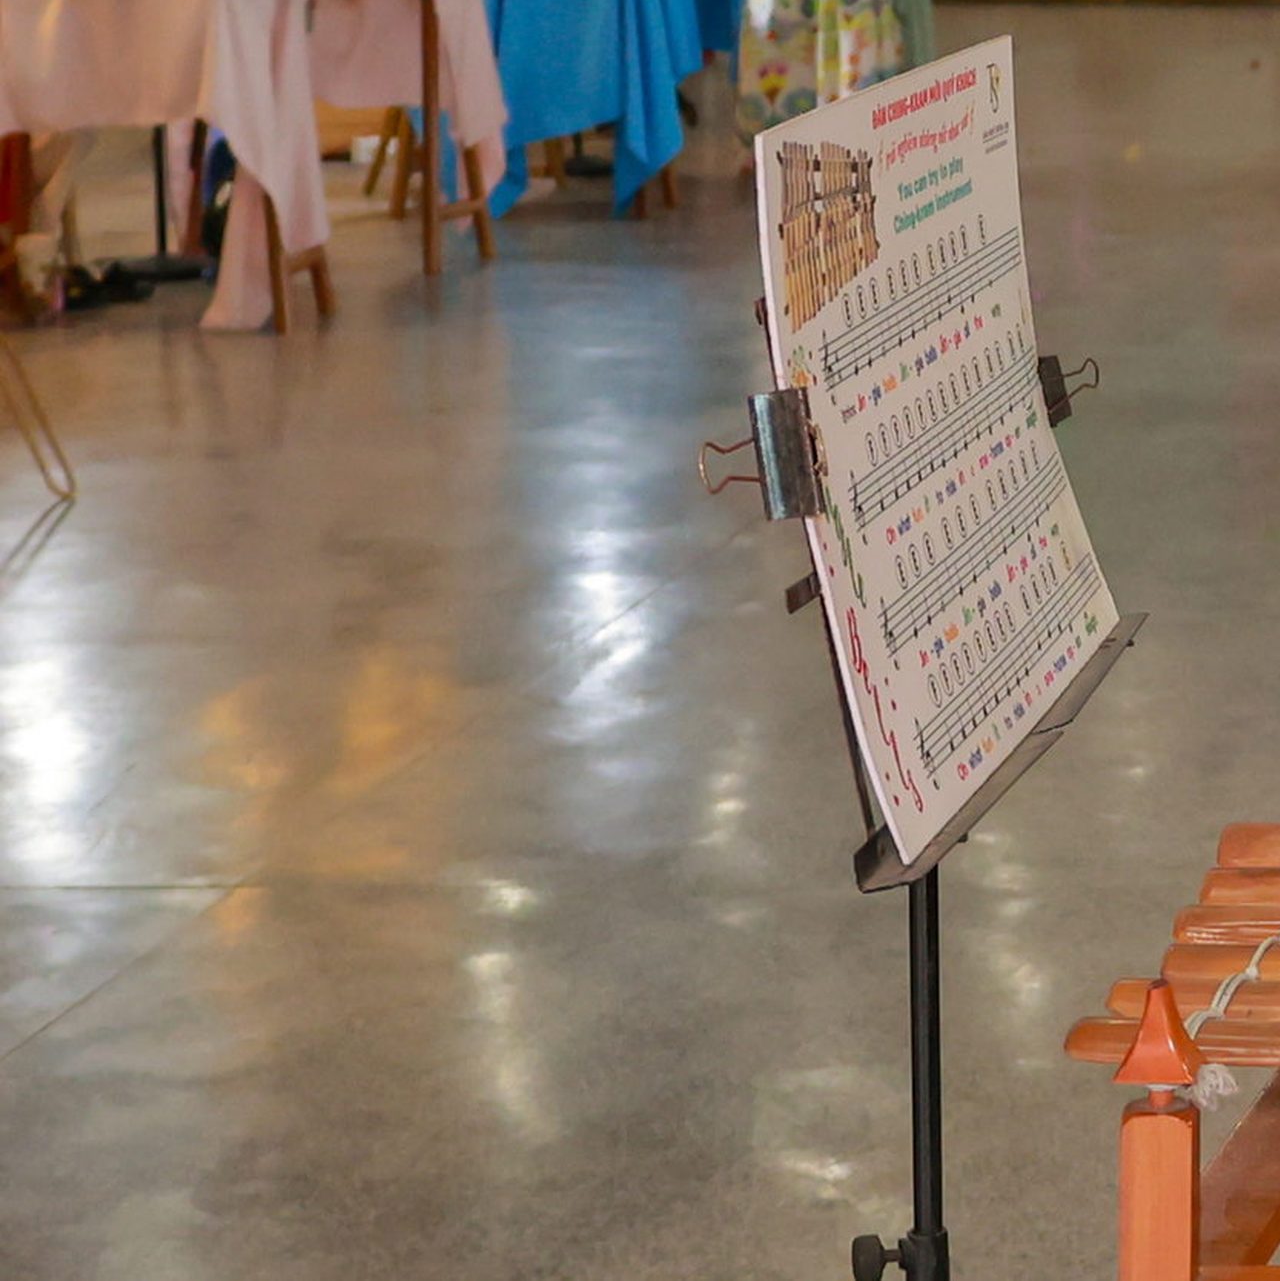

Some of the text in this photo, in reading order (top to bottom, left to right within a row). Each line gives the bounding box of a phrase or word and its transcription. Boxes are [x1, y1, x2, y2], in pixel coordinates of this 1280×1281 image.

[898, 156, 963, 201] You can try to play
[935, 177, 972, 211] instrument
